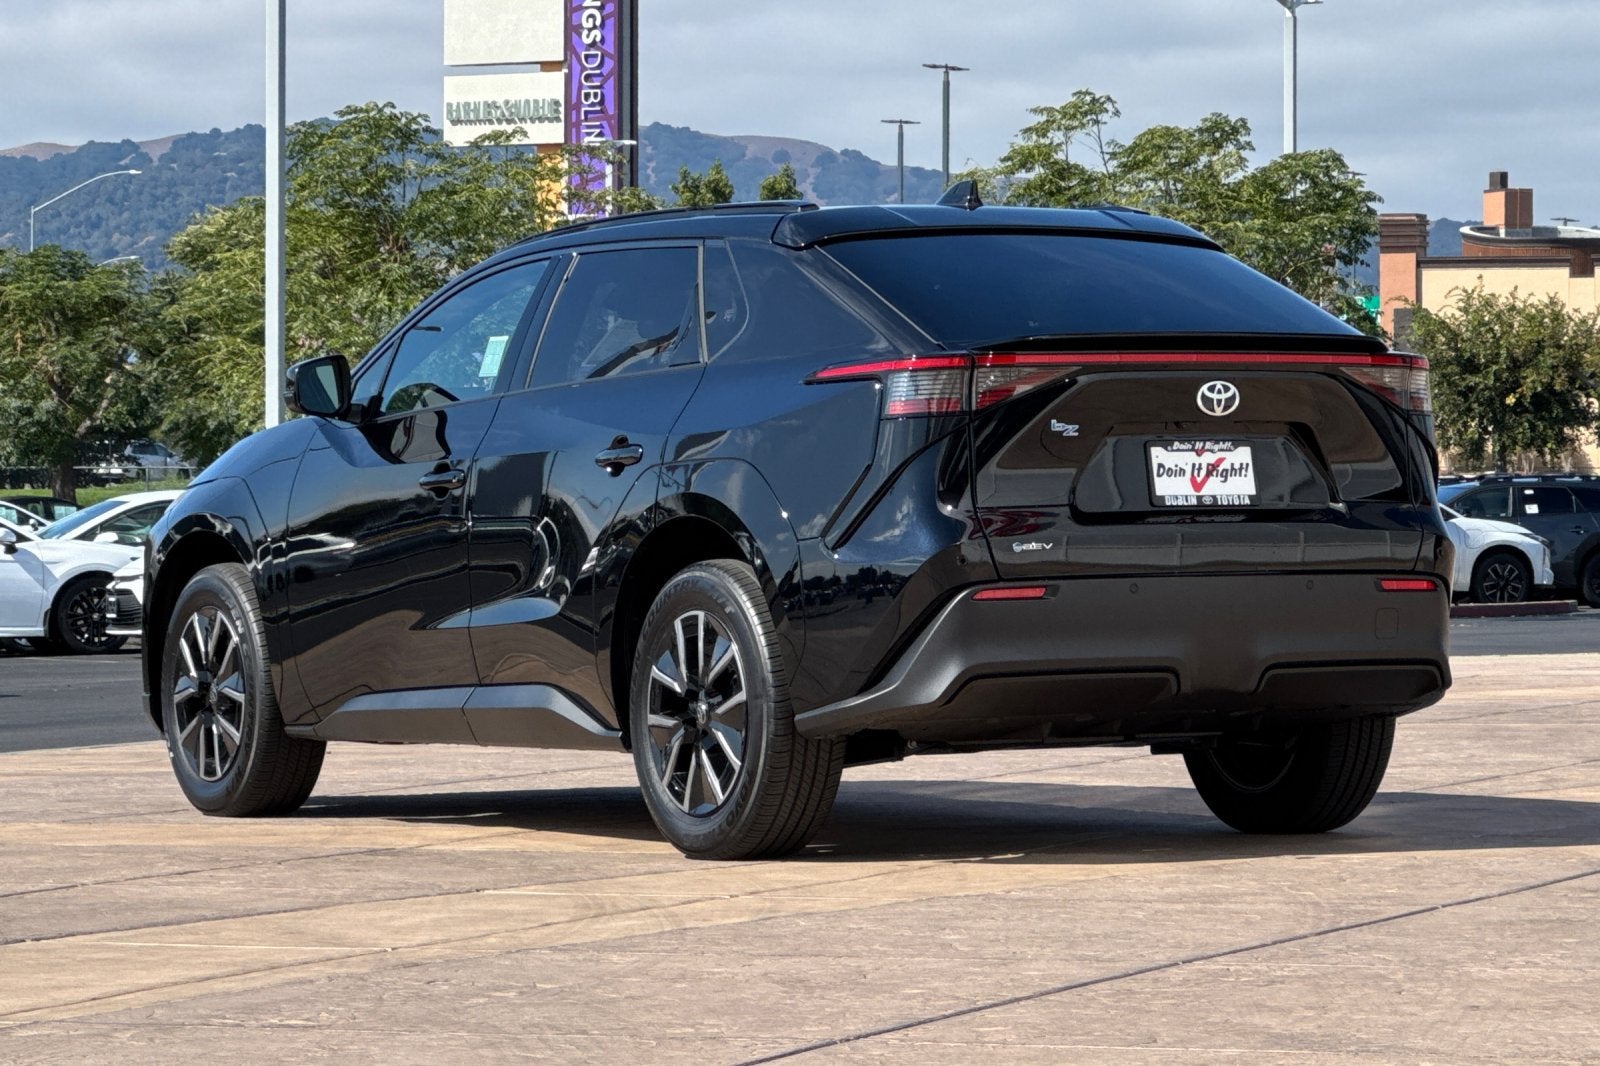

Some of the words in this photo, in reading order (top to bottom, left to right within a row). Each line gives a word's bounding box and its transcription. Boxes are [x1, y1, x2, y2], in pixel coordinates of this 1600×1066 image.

[581, 51, 602, 146] DUBLIN
[1156, 462, 1188, 478] Doin'
[1191, 462, 1203, 478] It
[1206, 462, 1250, 483] Right!
[1165, 495, 1198, 506] DUBLIN
[1216, 495, 1251, 506] TOYOTA
